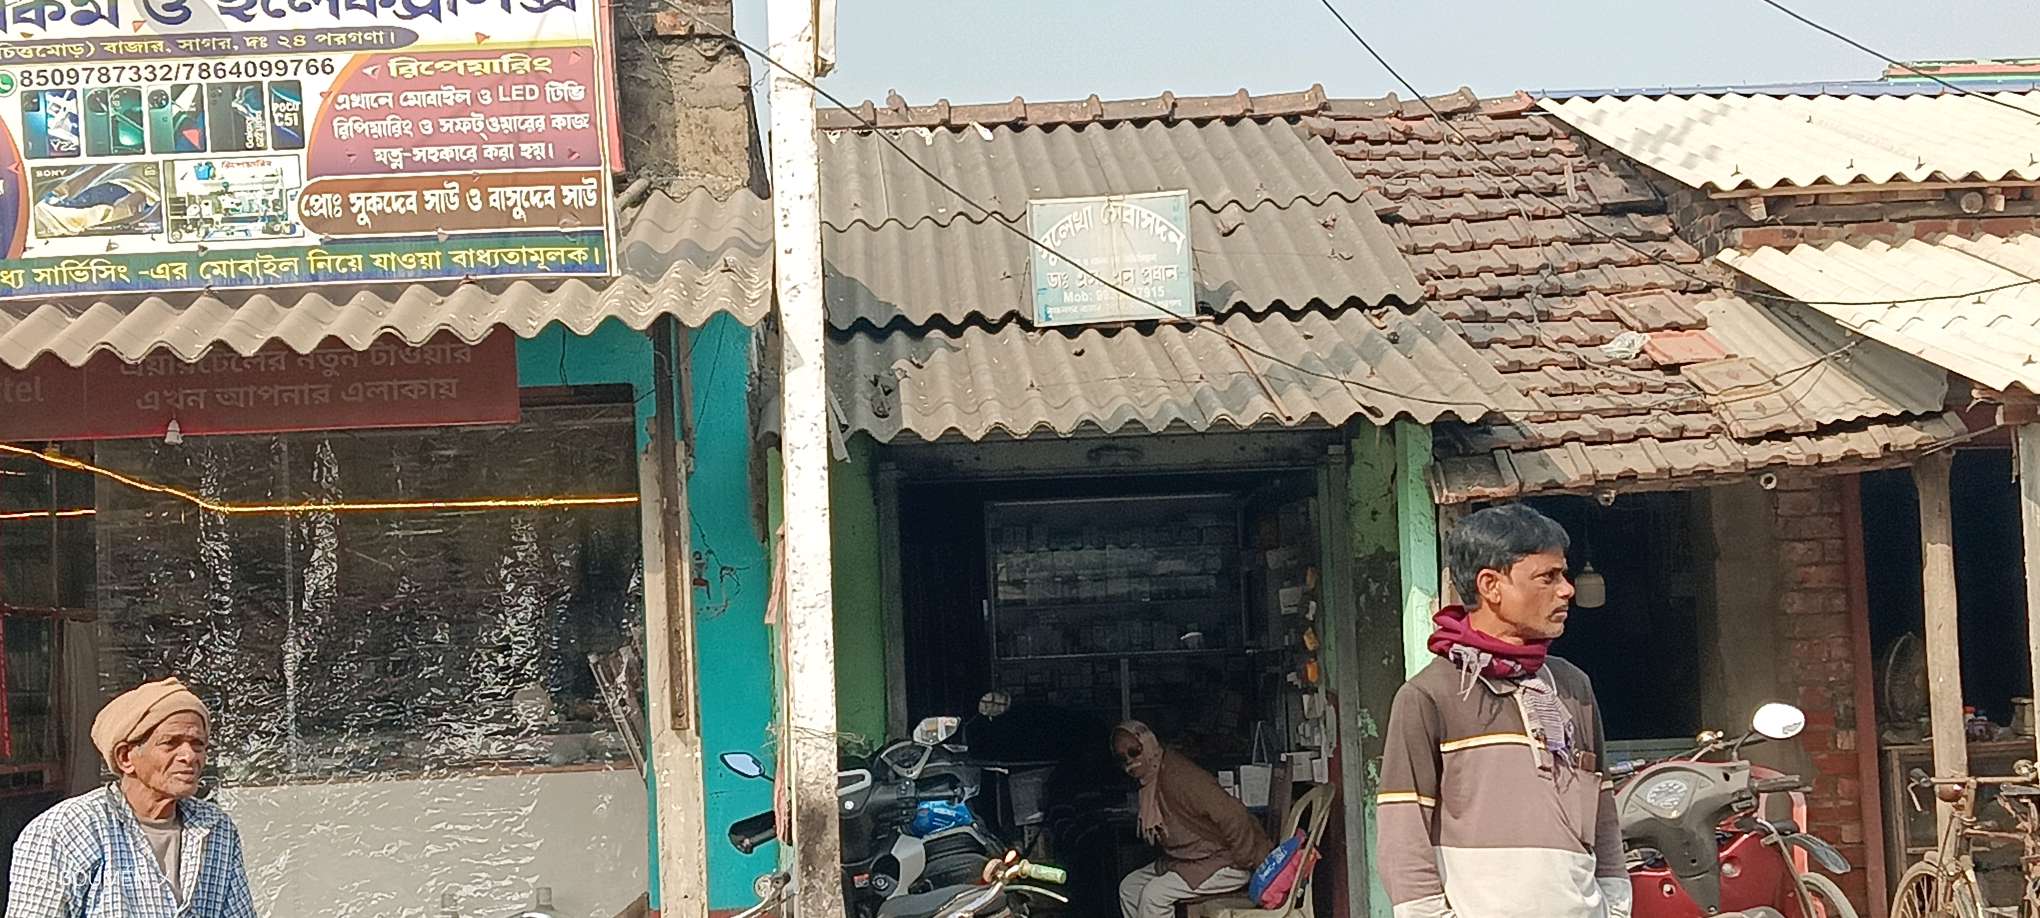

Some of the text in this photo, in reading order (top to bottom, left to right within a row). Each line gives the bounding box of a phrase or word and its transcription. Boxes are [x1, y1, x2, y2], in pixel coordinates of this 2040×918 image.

[100, 39, 172, 55] বাজার,
[177, 36, 239, 52] সাগর,
[243, 35, 268, 49] দঃ
[278, 33, 306, 49] ২৪
[20, 57, 335, 88] 8509787332/7864099766
[387, 52, 553, 79] রিপেয়ারিং
[334, 80, 586, 112] এখানে মোবাইল ও LED টিভি
[273, 112, 300, 127] C51
[332, 114, 414, 141] রিপিয়ারিং
[418, 118, 434, 135] ও
[550, 113, 590, 131] কাজ
[483, 143, 515, 161] করা
[35, 169, 68, 178] SONY
[300, 176, 598, 229] প্রোঃ সুকদেব সাউ ও বাসুদেব সাউ
[32, 258, 130, 287] সার্ভিসিং
[199, 252, 300, 280] মোবাইল
[306, 248, 363, 274] নিয়ে
[371, 248, 442, 272] যাওয়া
[135, 377, 460, 412] এখন আপনার এলাকায়
